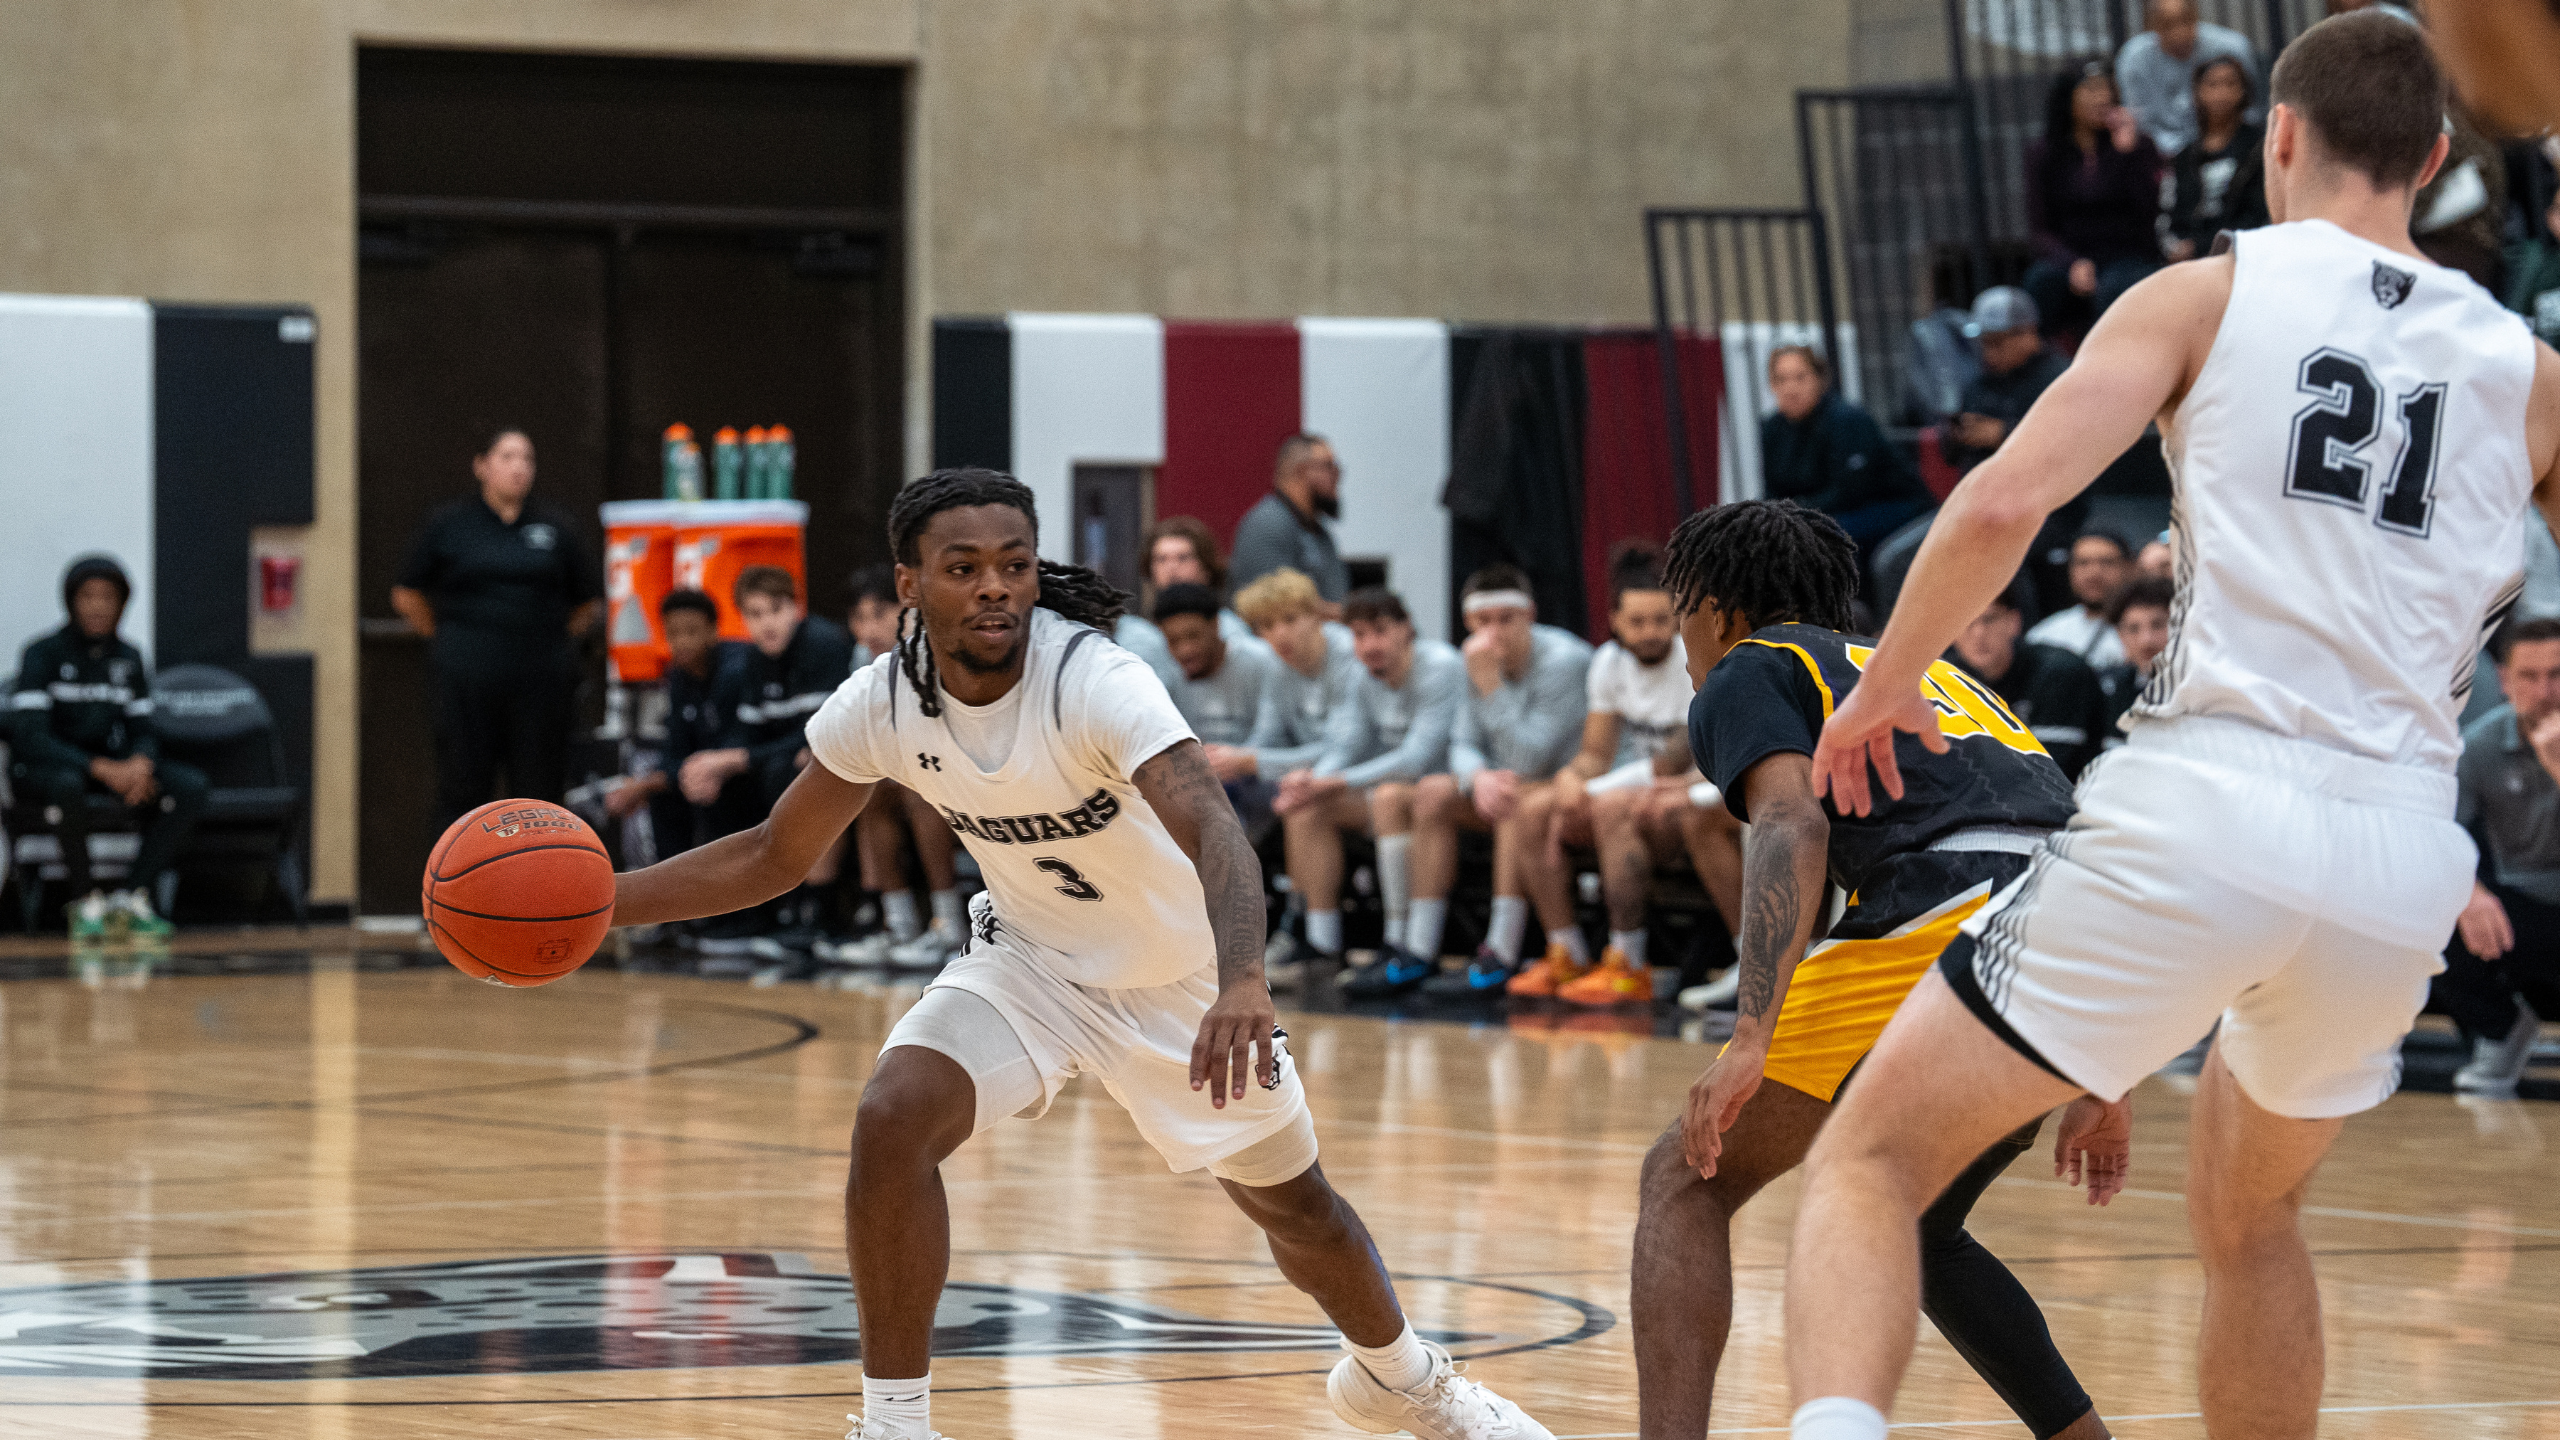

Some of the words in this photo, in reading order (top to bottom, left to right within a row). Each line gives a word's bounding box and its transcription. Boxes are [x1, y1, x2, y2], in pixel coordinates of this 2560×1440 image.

[2283, 345, 2448, 540] 21
[481, 808, 582, 833] LEGAC
[940, 787, 1121, 845] JAGUARS
[1032, 856, 1104, 902] 3
